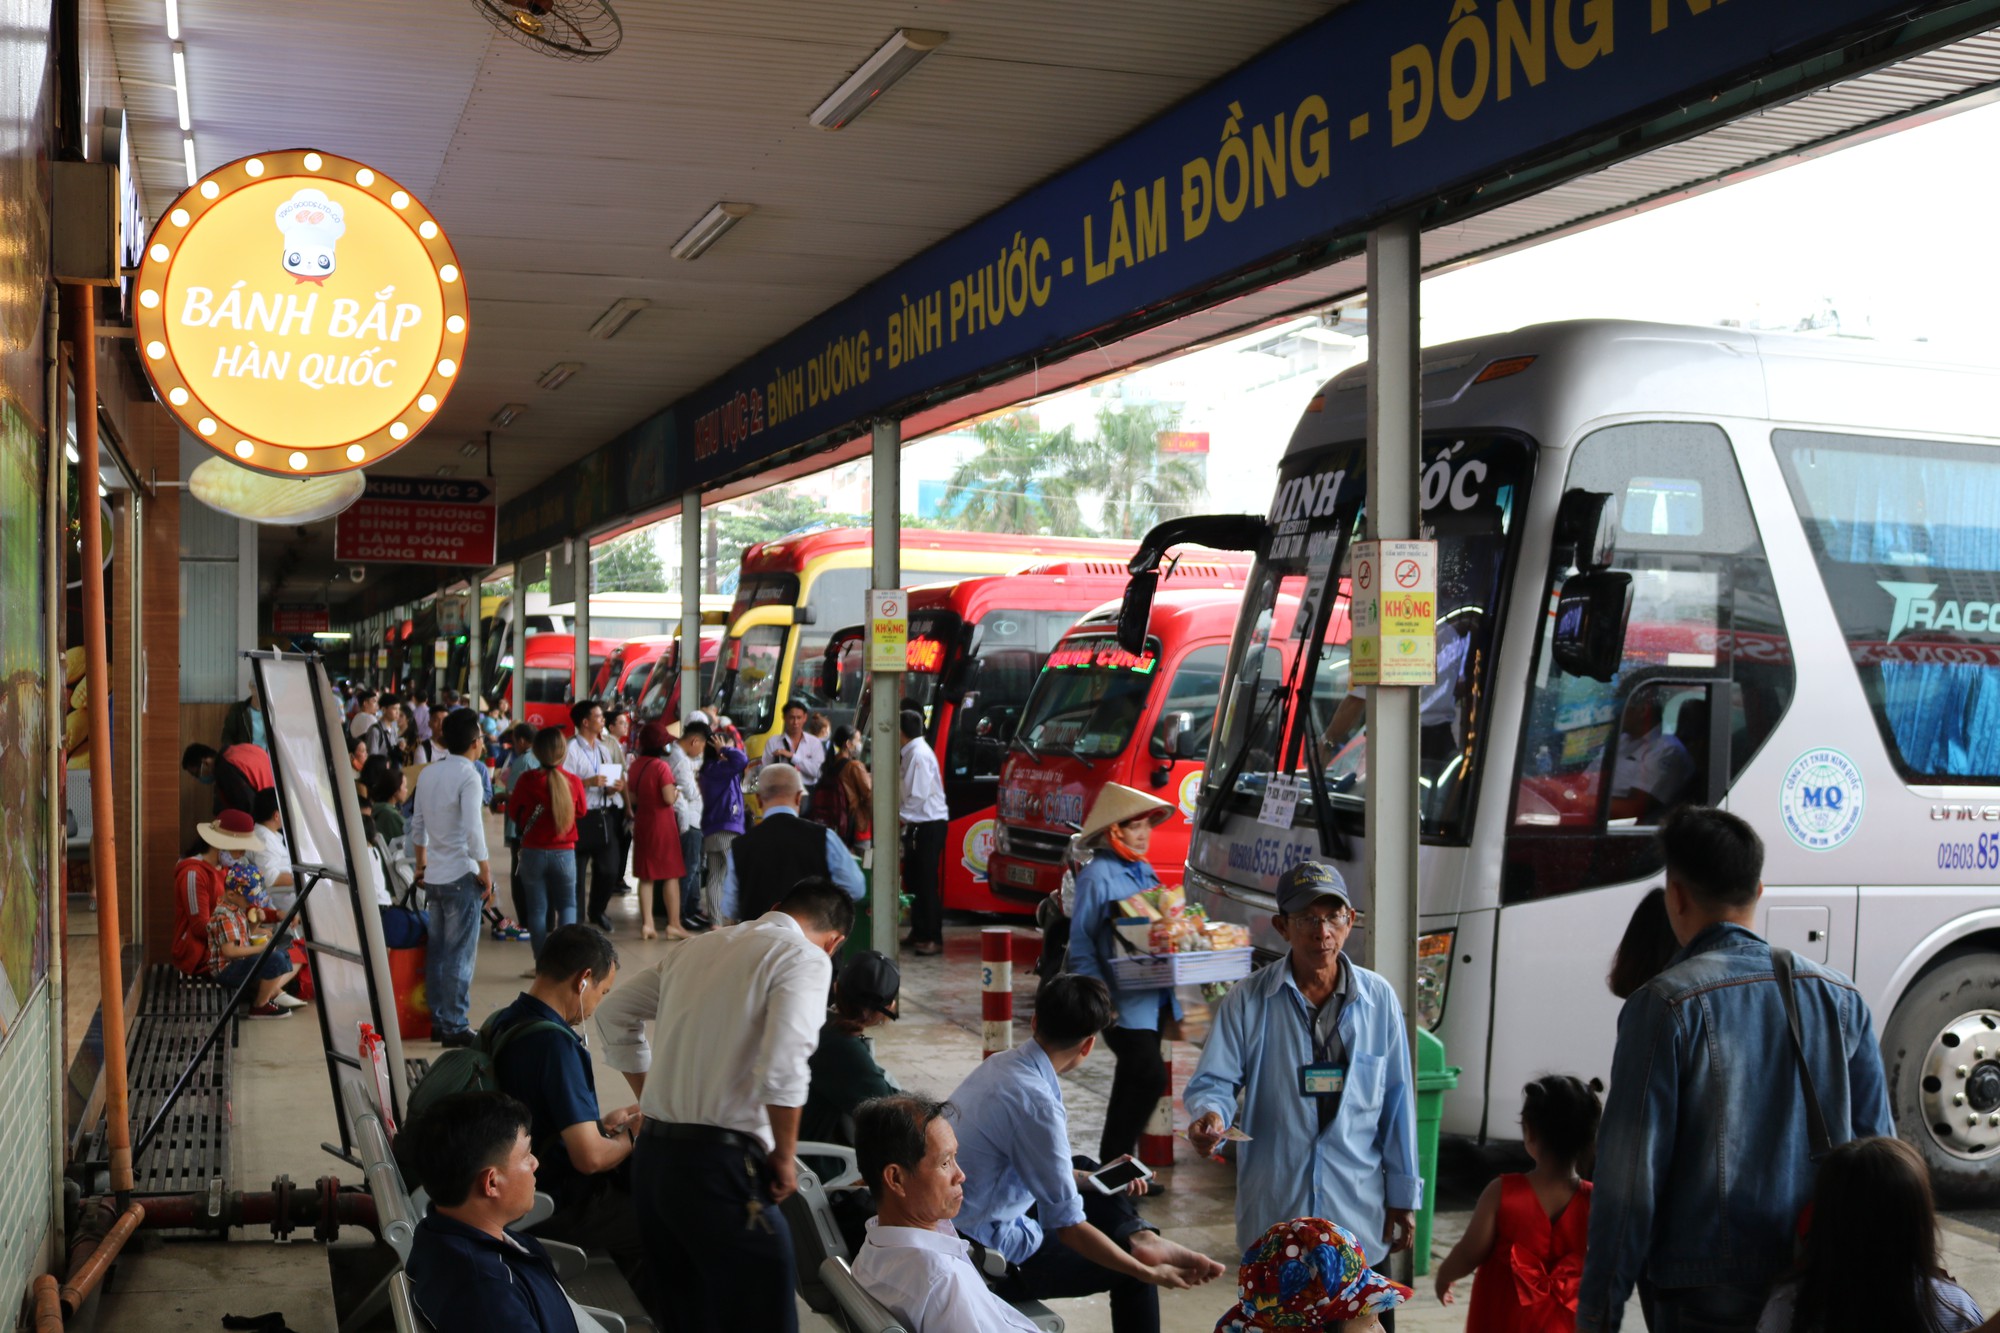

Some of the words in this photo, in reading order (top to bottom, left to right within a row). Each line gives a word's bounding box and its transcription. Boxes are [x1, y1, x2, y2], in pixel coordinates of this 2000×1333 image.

[694, 408, 719, 463] KHU
[767, 367, 804, 428] BÌNH
[807, 329, 870, 408] DƯƠNG
[888, 290, 941, 371] BÌNH
[950, 230, 1051, 343] PHƯỚC
[1083, 176, 1168, 286] LÂM
[1181, 94, 1330, 242] ĐỒNG
[180, 279, 319, 336] BÁNH
[327, 284, 422, 342] BẮP
[212, 341, 291, 380] HÀN
[298, 346, 397, 390] QUỐC
[1420, 440, 1488, 511] ỐC
[366, 481, 411, 495] KHU
[418, 482, 460, 499] VỰC
[466, 486, 479, 498] 2
[360, 503, 409, 517] BÌNH
[415, 506, 487, 520] DƯƠNG
[358, 517, 409, 531] BÌNH
[358, 531, 401, 545] LÂM
[422, 548, 457, 560] NAI
[1802, 786, 1843, 810] MQ
[1930, 804, 2000, 821] UNIVE
[982, 967, 992, 987] 3
